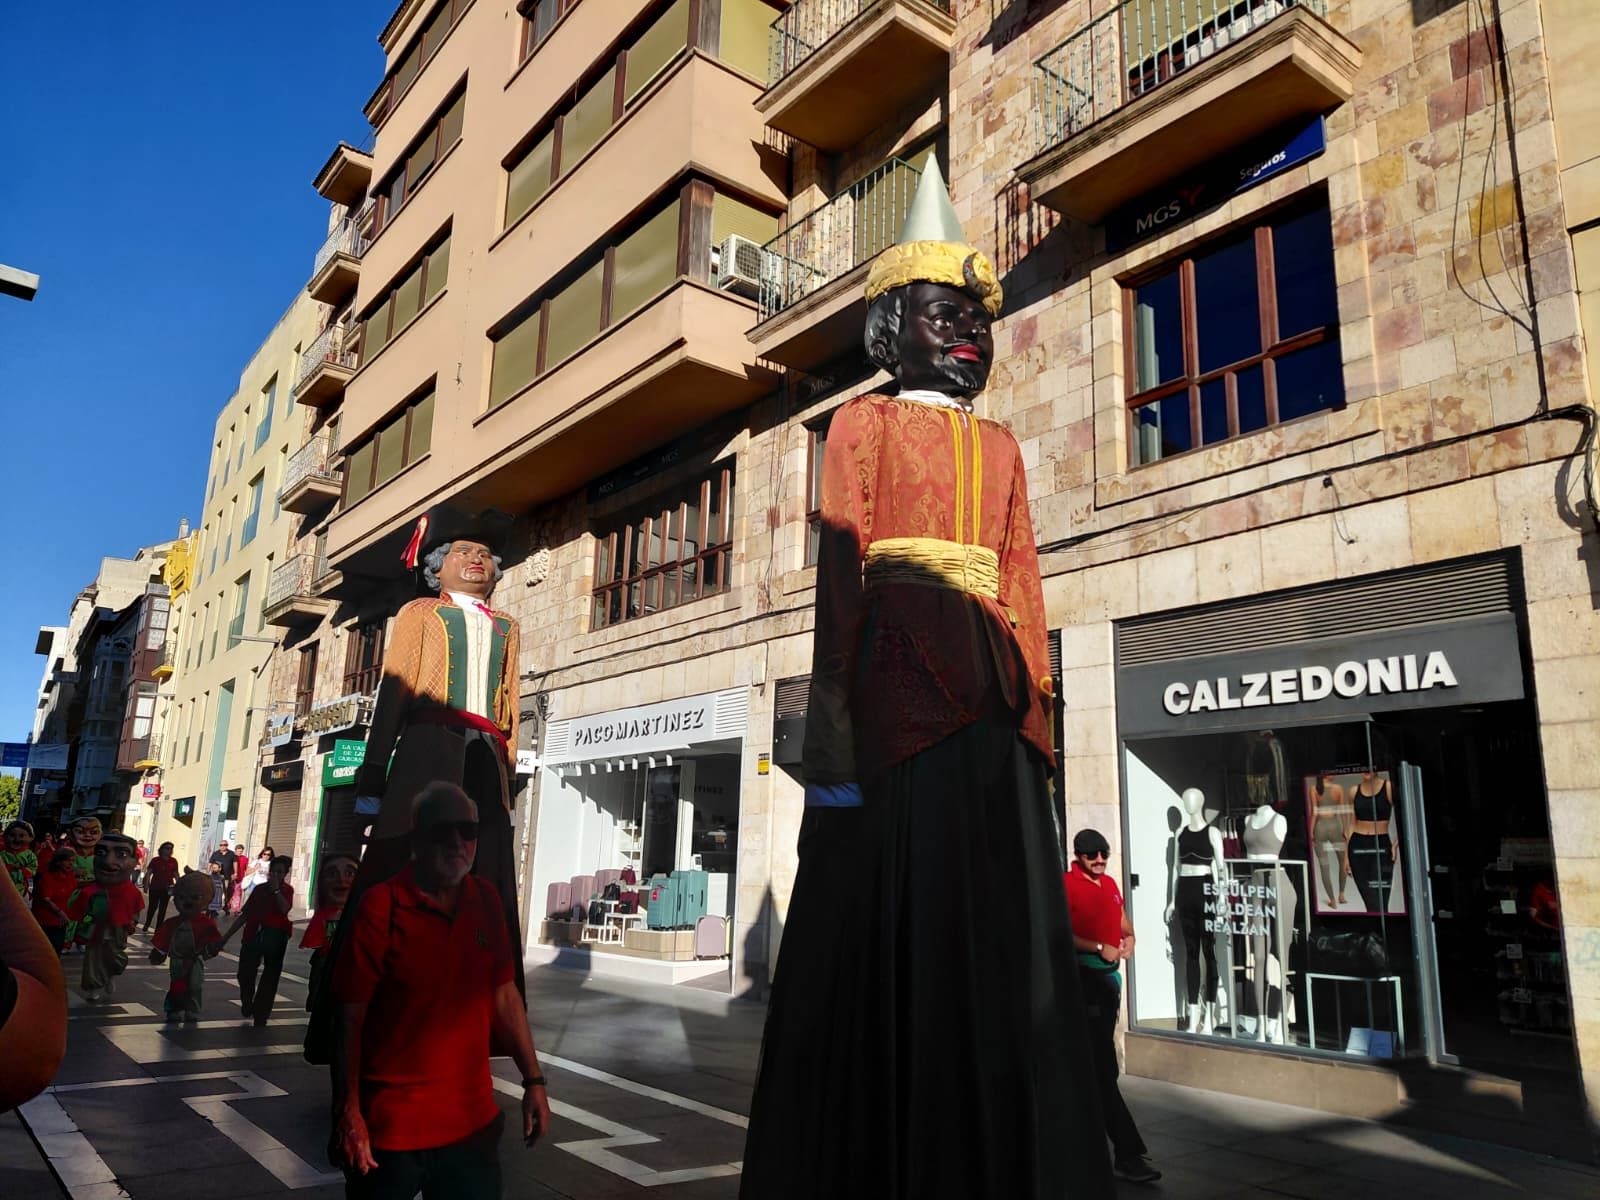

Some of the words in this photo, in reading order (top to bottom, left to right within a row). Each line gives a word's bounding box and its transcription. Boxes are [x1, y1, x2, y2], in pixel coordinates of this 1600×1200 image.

[1135, 199, 1181, 235] MGS
[1239, 150, 1286, 179] Seguros
[1163, 650, 1458, 715] CALZEDONIA
[574, 707, 705, 746] PACOMARTINEZ
[1203, 882, 1277, 898] ESCULPEN
[1204, 902, 1276, 918] MOLDEAN
[1205, 919, 1271, 936] REALZAN
